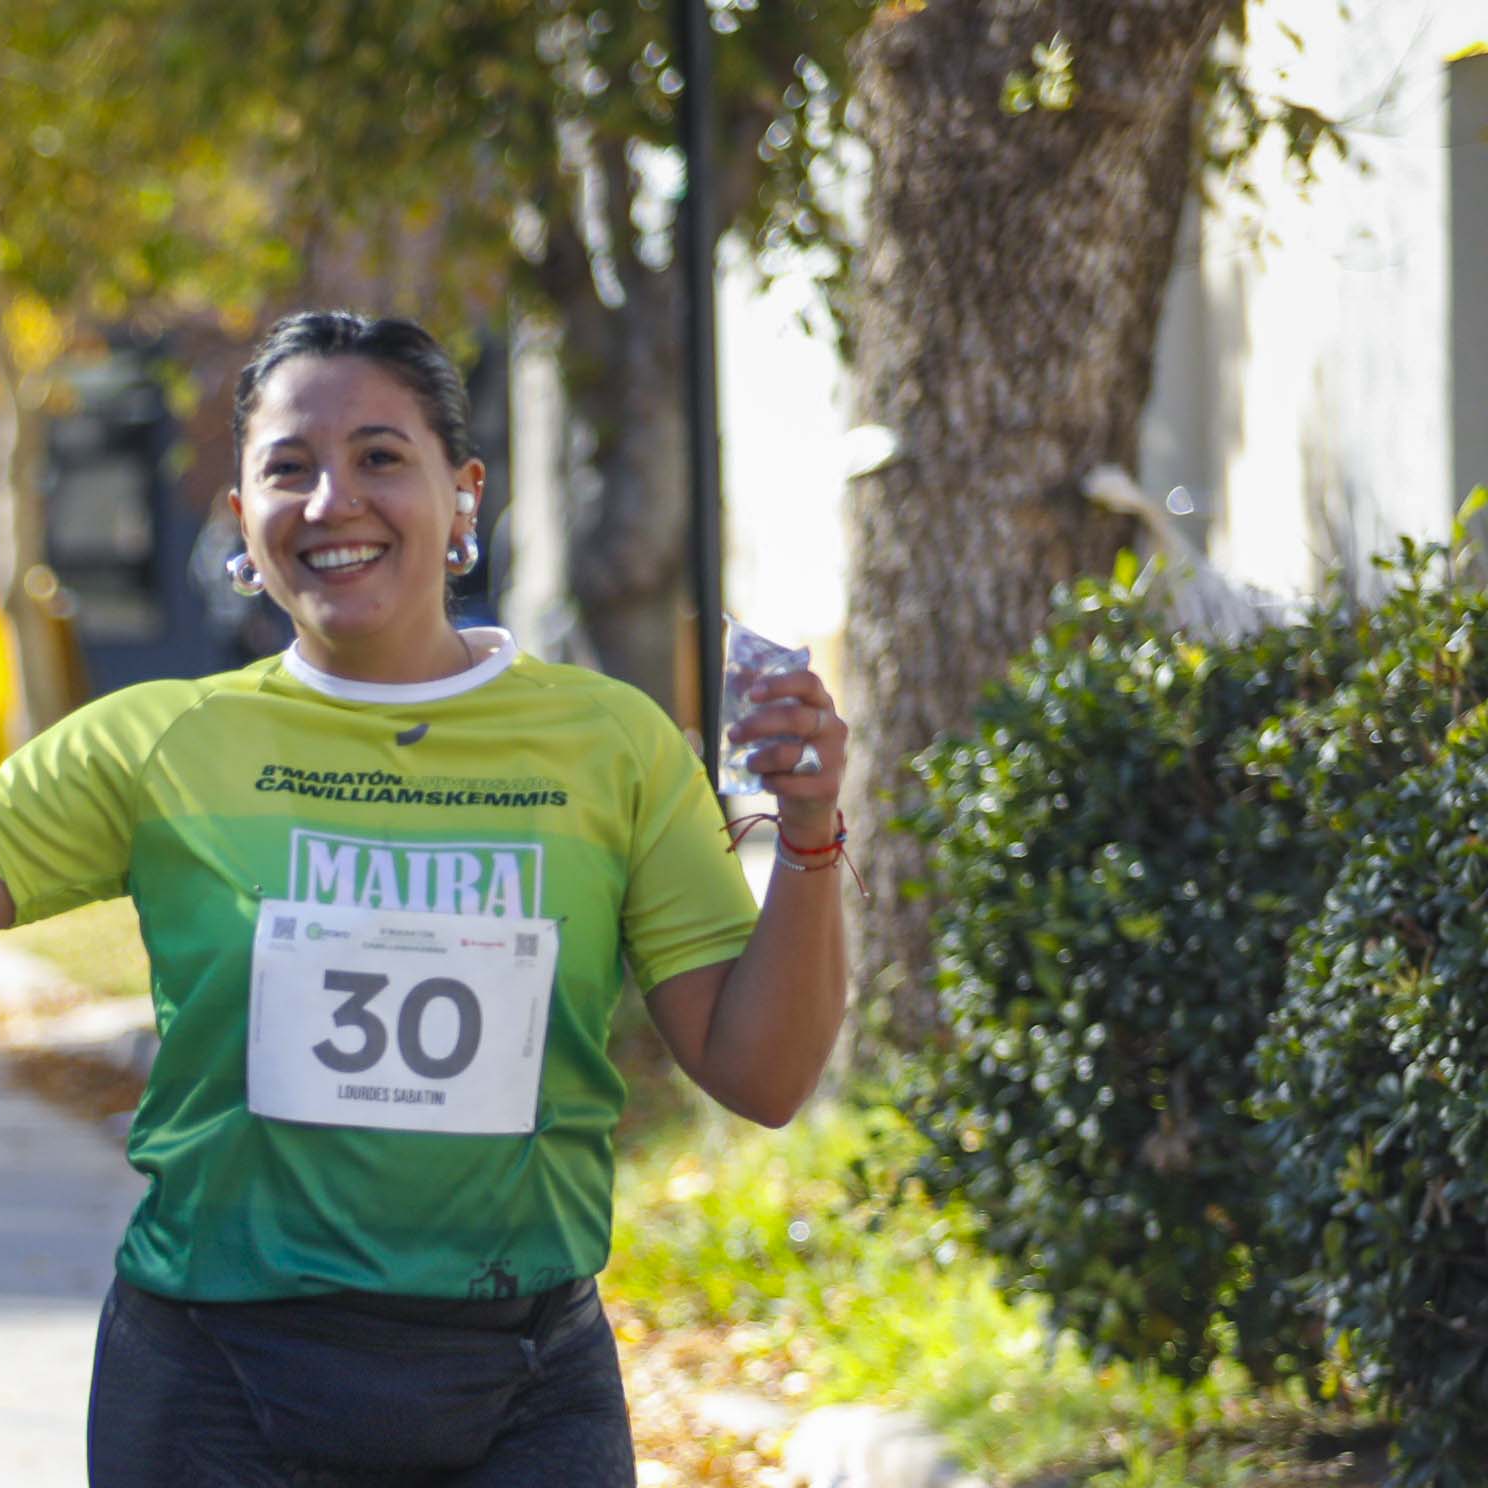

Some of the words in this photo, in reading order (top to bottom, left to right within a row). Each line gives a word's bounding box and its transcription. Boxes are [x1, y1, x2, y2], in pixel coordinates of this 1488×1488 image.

[255, 777, 568, 807] CAWILLIAMSKEMMIS
[306, 838, 524, 920] MAIRA
[311, 969, 483, 1080] 30
[337, 1084, 389, 1103] LOURDES
